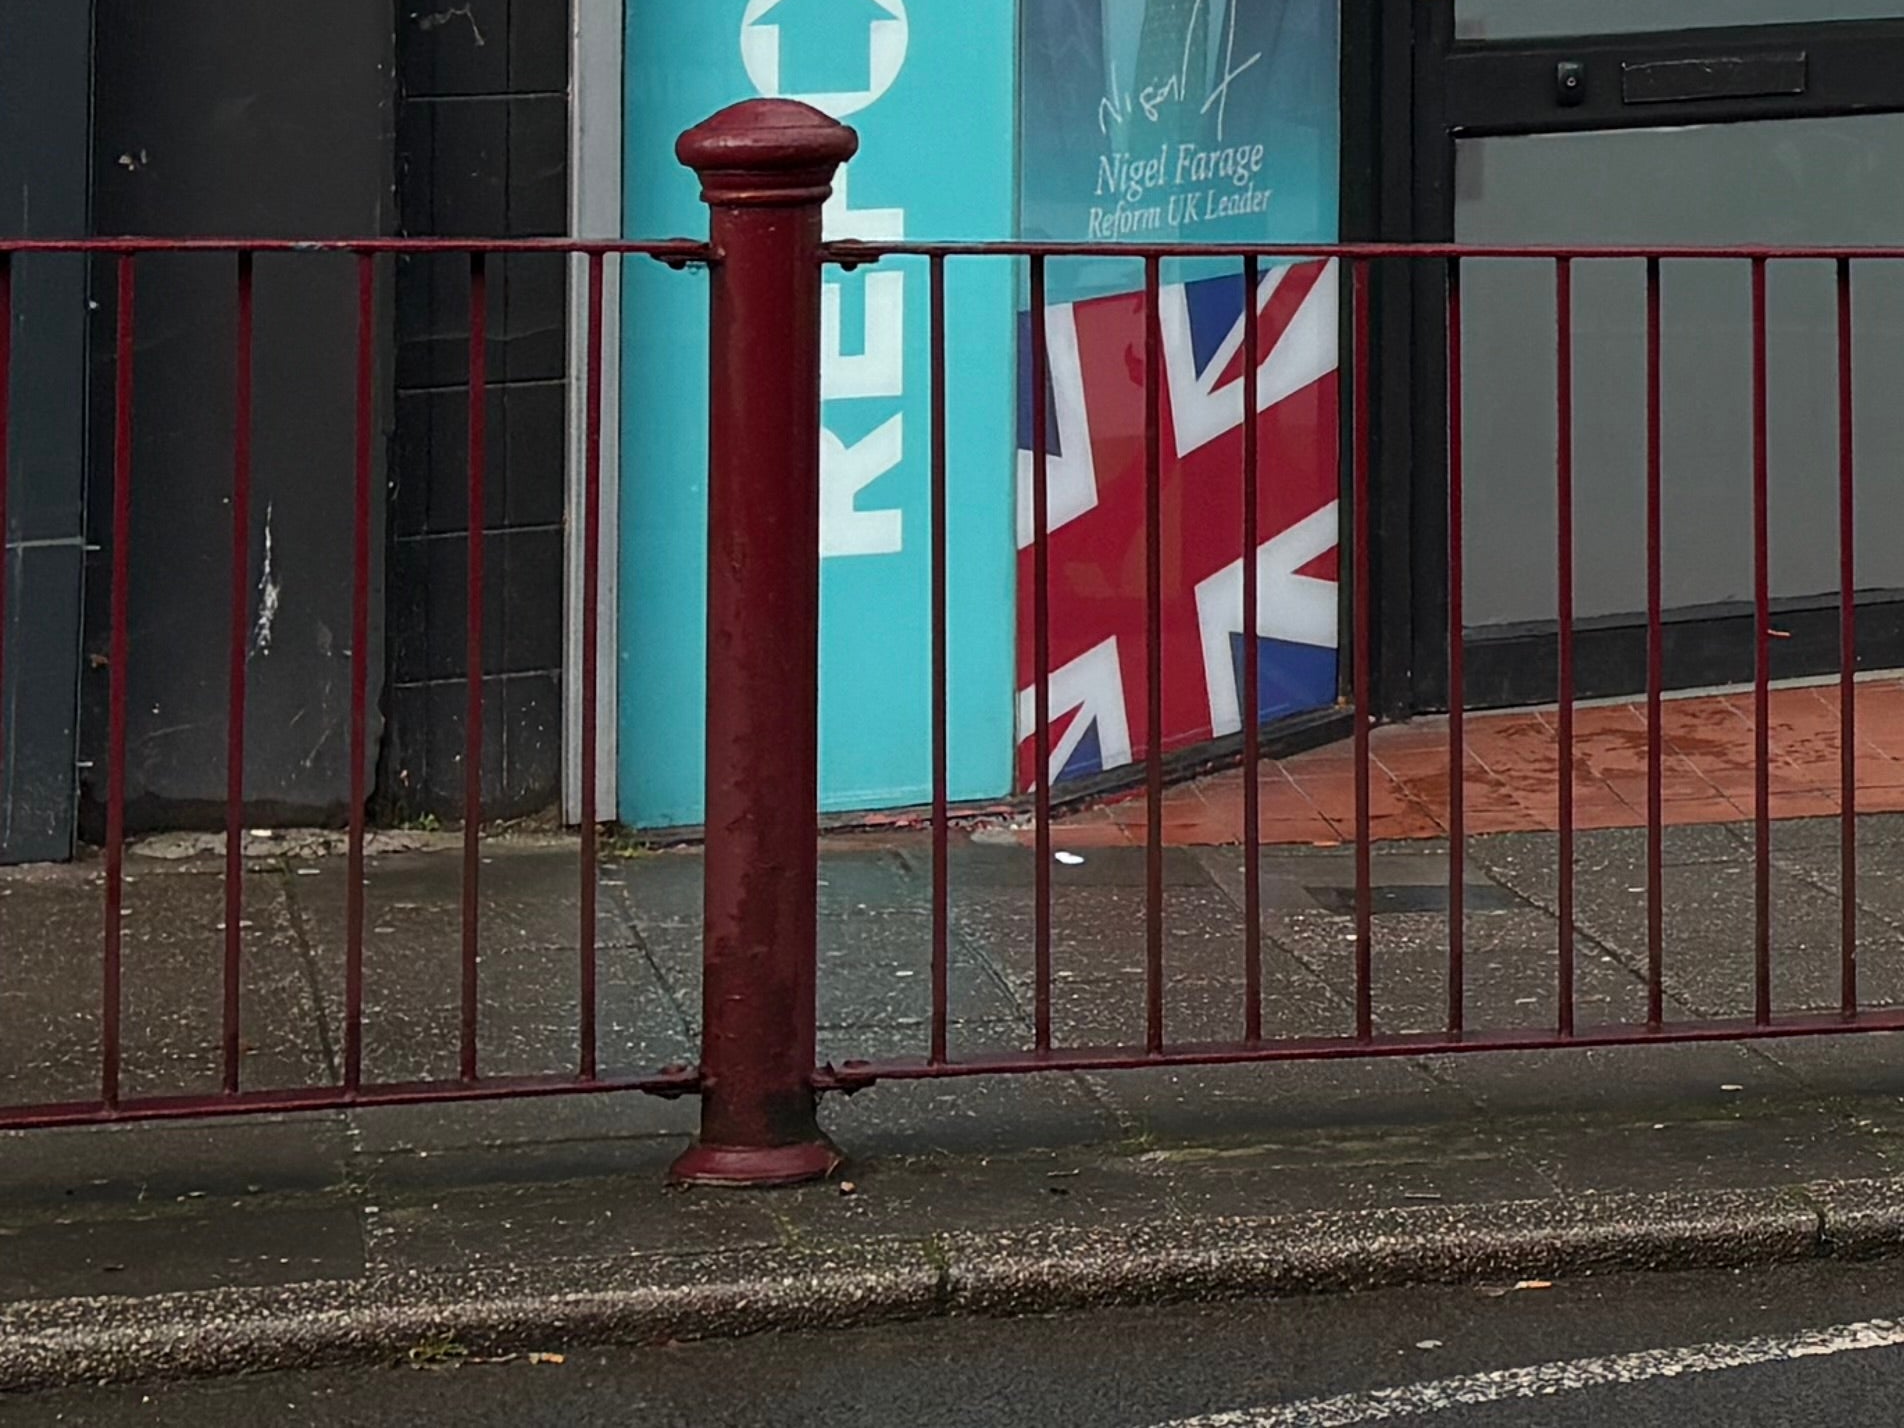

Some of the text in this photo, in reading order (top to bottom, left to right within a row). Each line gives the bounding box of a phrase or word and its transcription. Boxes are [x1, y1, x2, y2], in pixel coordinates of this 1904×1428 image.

[1095, 143, 1264, 202] Nigel Farage
[1088, 181, 1273, 242] Reform UK Leader
